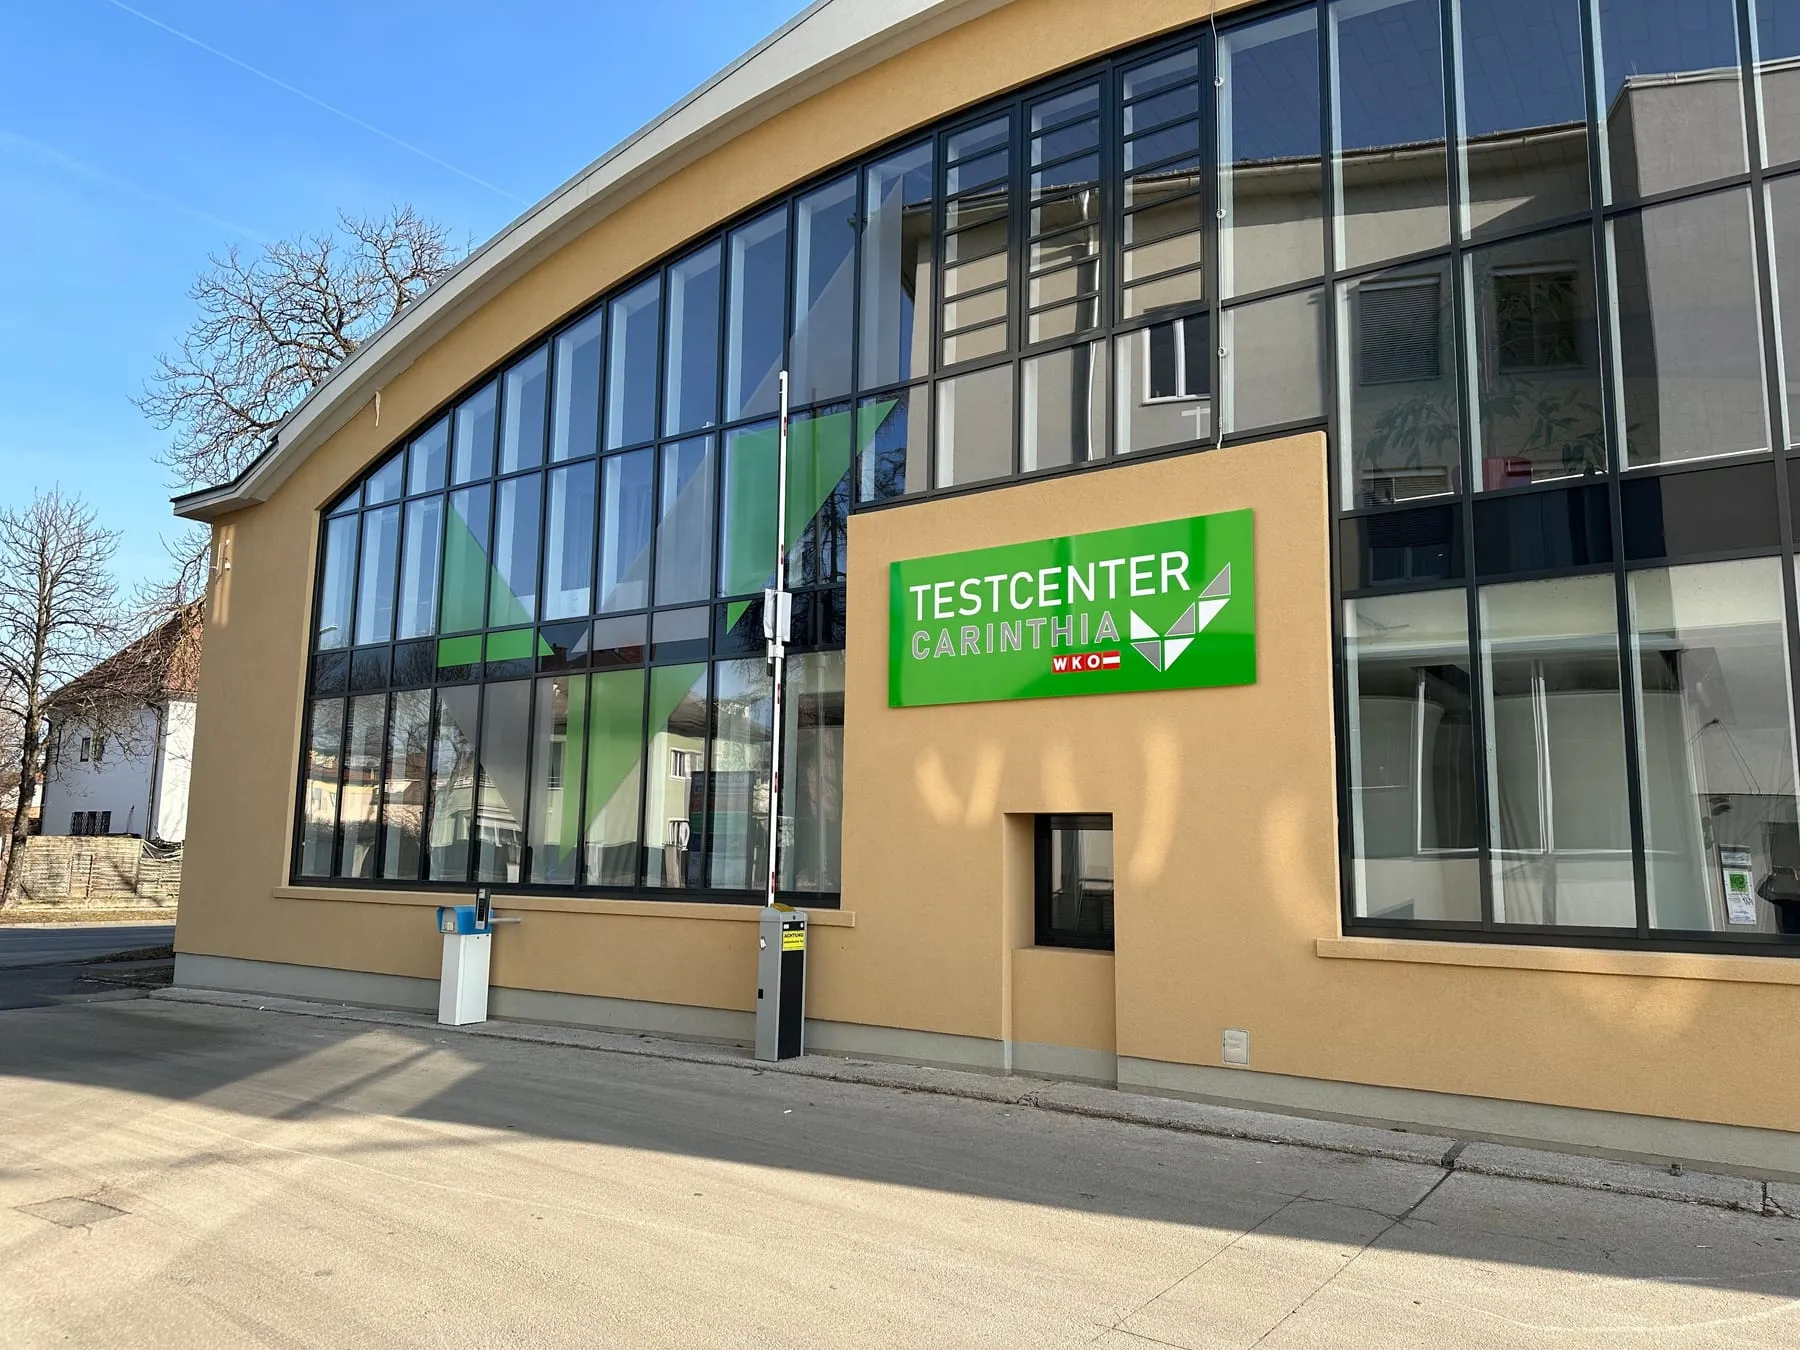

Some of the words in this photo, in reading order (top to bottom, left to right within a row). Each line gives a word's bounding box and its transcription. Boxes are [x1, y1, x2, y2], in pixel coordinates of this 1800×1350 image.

[909, 550, 1191, 622] TESTCENTER
[911, 611, 1120, 660] CARINTHIA
[1053, 654, 1101, 672] WKO
